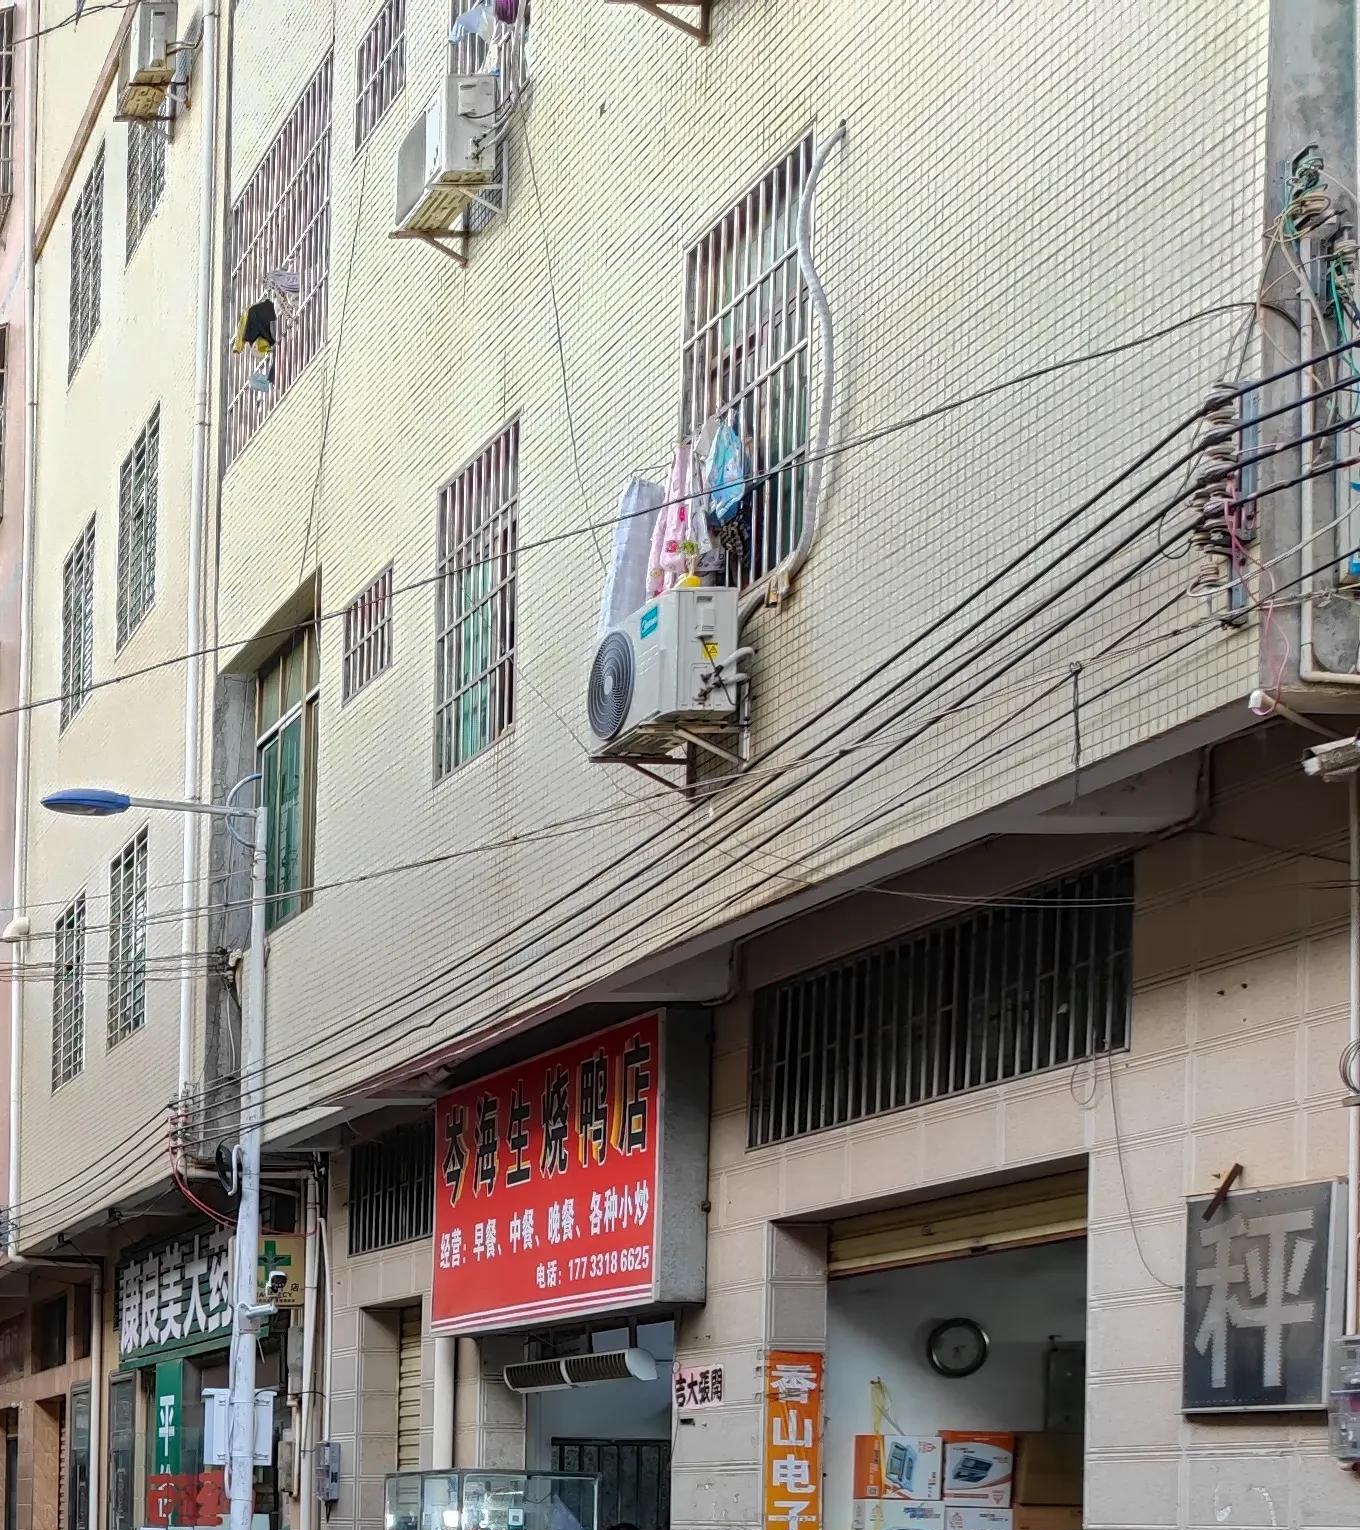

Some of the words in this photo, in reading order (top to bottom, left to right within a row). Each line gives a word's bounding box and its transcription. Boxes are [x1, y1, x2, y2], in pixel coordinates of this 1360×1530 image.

[441, 1033, 653, 1209] 岑海生烧鸭店
[567, 1255, 589, 1282] 177
[589, 1251, 618, 1280] 3318
[619, 1244, 650, 1273] 6625
[1194, 1209, 1316, 1389] 秤
